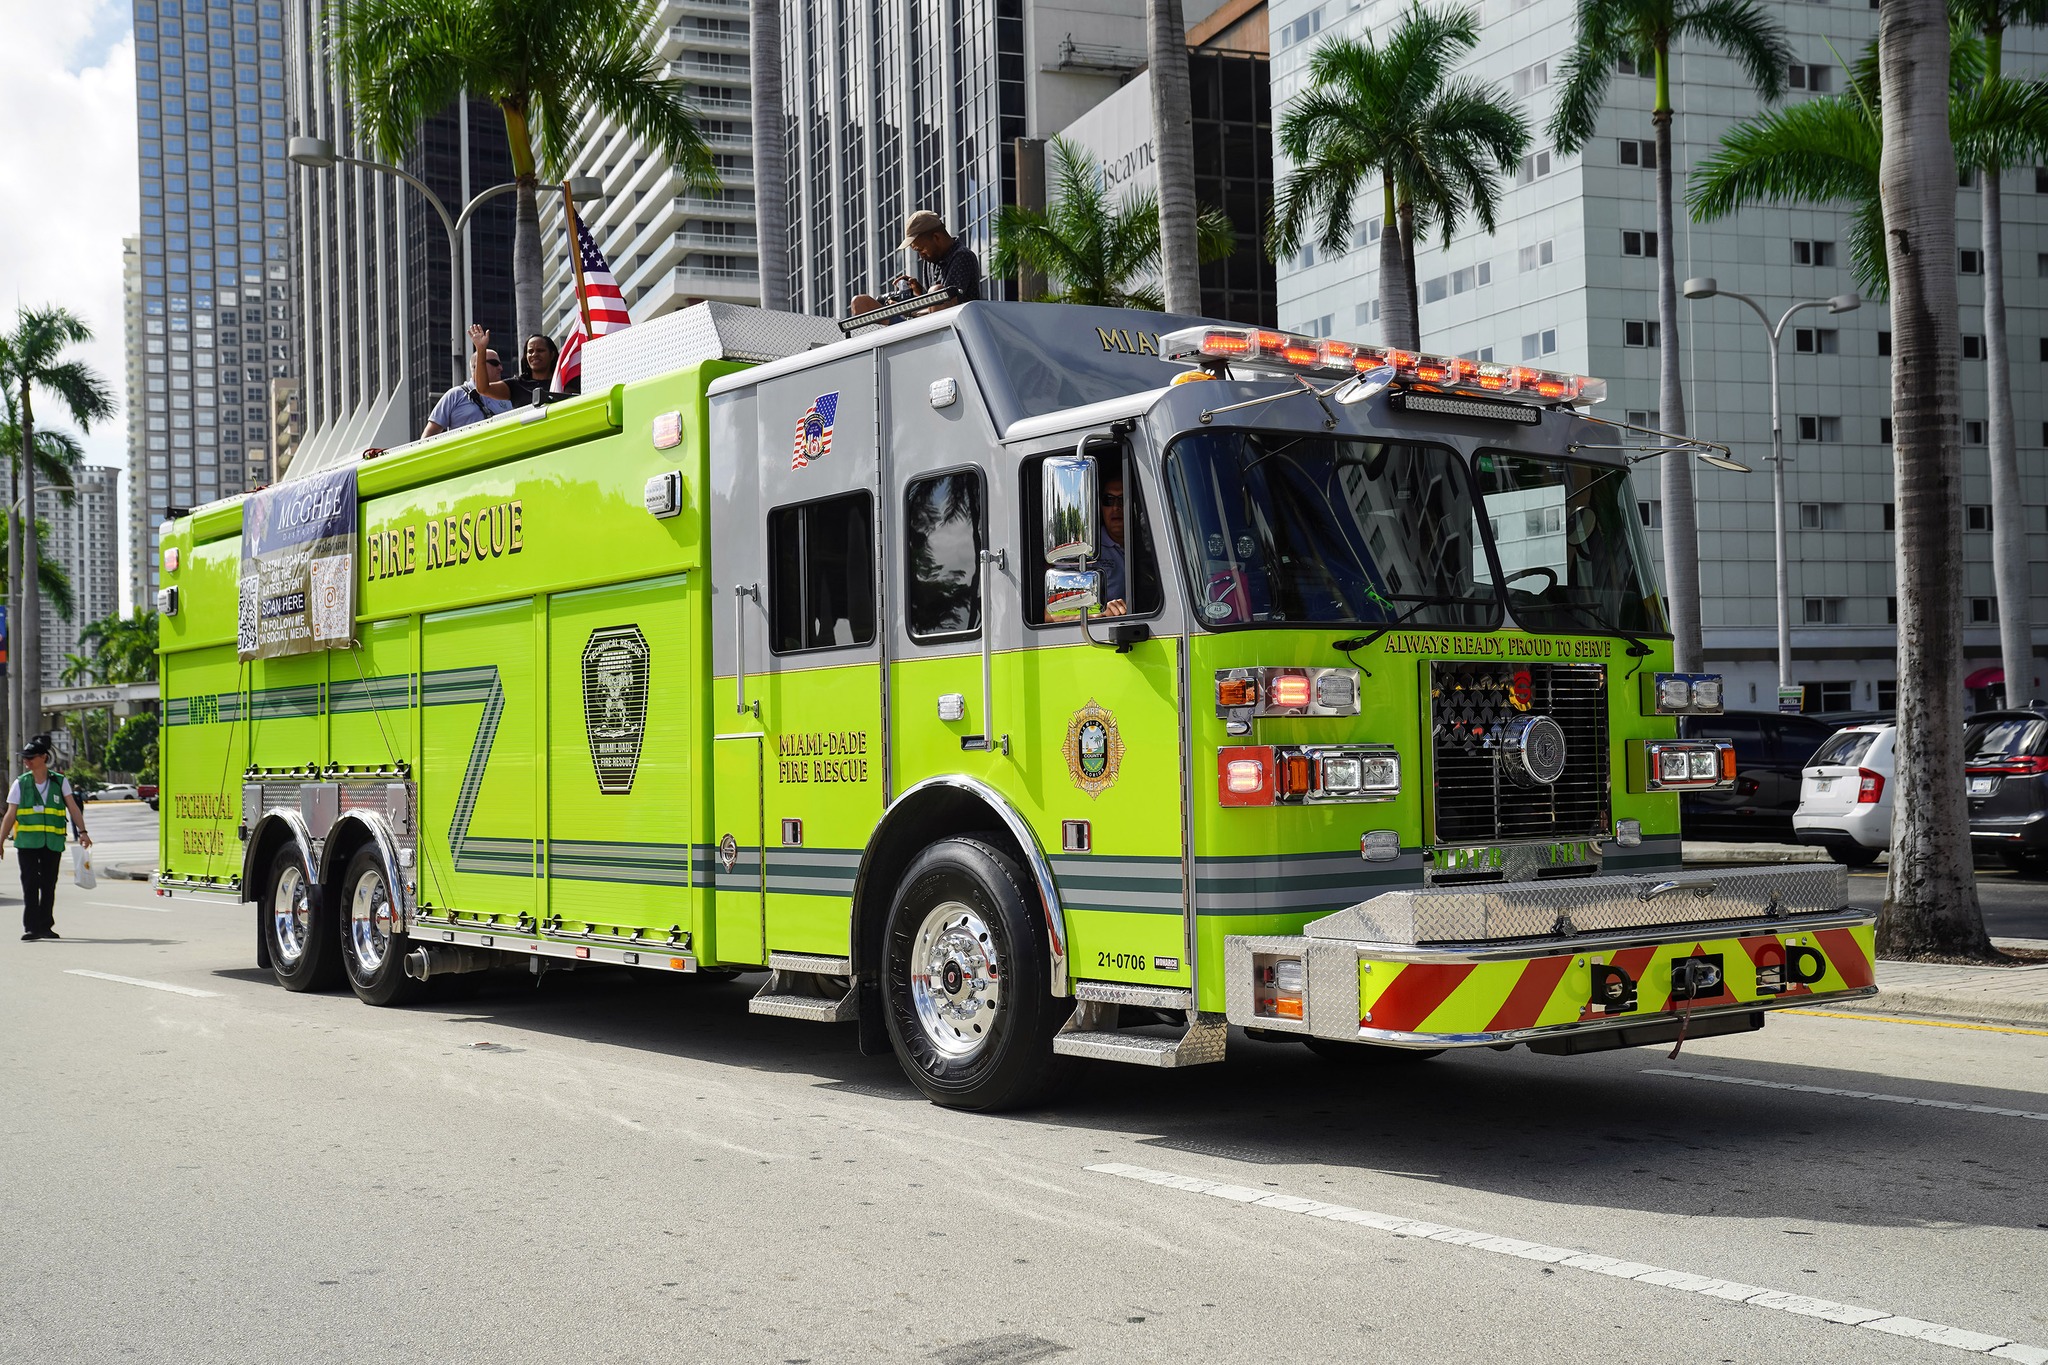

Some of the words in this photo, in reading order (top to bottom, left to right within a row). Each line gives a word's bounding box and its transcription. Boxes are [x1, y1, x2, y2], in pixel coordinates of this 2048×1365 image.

[283, 525, 321, 541] DISTRICT
[368, 525, 416, 582] FIRE
[426, 500, 523, 571] RESCUE
[261, 563, 267, 573] TO
[267, 558, 281, 571] STAY
[282, 552, 310, 569] UPDATED
[271, 571, 279, 582] ON
[281, 568, 292, 580] THE
[263, 582, 283, 596] LATEST
[284, 577, 304, 592] EVENT
[262, 598, 281, 615] SCAN
[282, 594, 304, 611] HERE
[261, 621, 267, 632] TO
[268, 617, 294, 630] FOLLOW
[295, 615, 305, 626] ME
[259, 634, 267, 645] ON
[267, 630, 288, 643] SOCIAL
[289, 626, 311, 639] MEDIA
[1384, 634, 1450, 653] ALWAYS
[1453, 636, 1504, 658] READY,
[1508, 638, 1551, 656] PROUD
[1555, 639, 1572, 656] TO
[1573, 640, 1612, 657] SERVE
[589, 638, 618, 662] TECHNICAL
[620, 639, 643, 659] RESCUE
[189, 694, 218, 725] MDFR
[1085, 707, 1099, 716] FIRE
[779, 731, 867, 756] MIAMI-DADE
[600, 757, 612, 767] FIRE
[613, 757, 632, 767] RESCUE
[779, 760, 808, 783] FIRE
[814, 759, 868, 782] RESCUE
[1083, 767, 1105, 778] FLORIDA
[175, 793, 234, 819] TECHNICAL
[183, 829, 225, 856] RESCUE
[1432, 847, 1501, 870] MDFR
[1097, 951, 1146, 971] 21-0706
[1155, 958, 1178, 967] MONARCH
